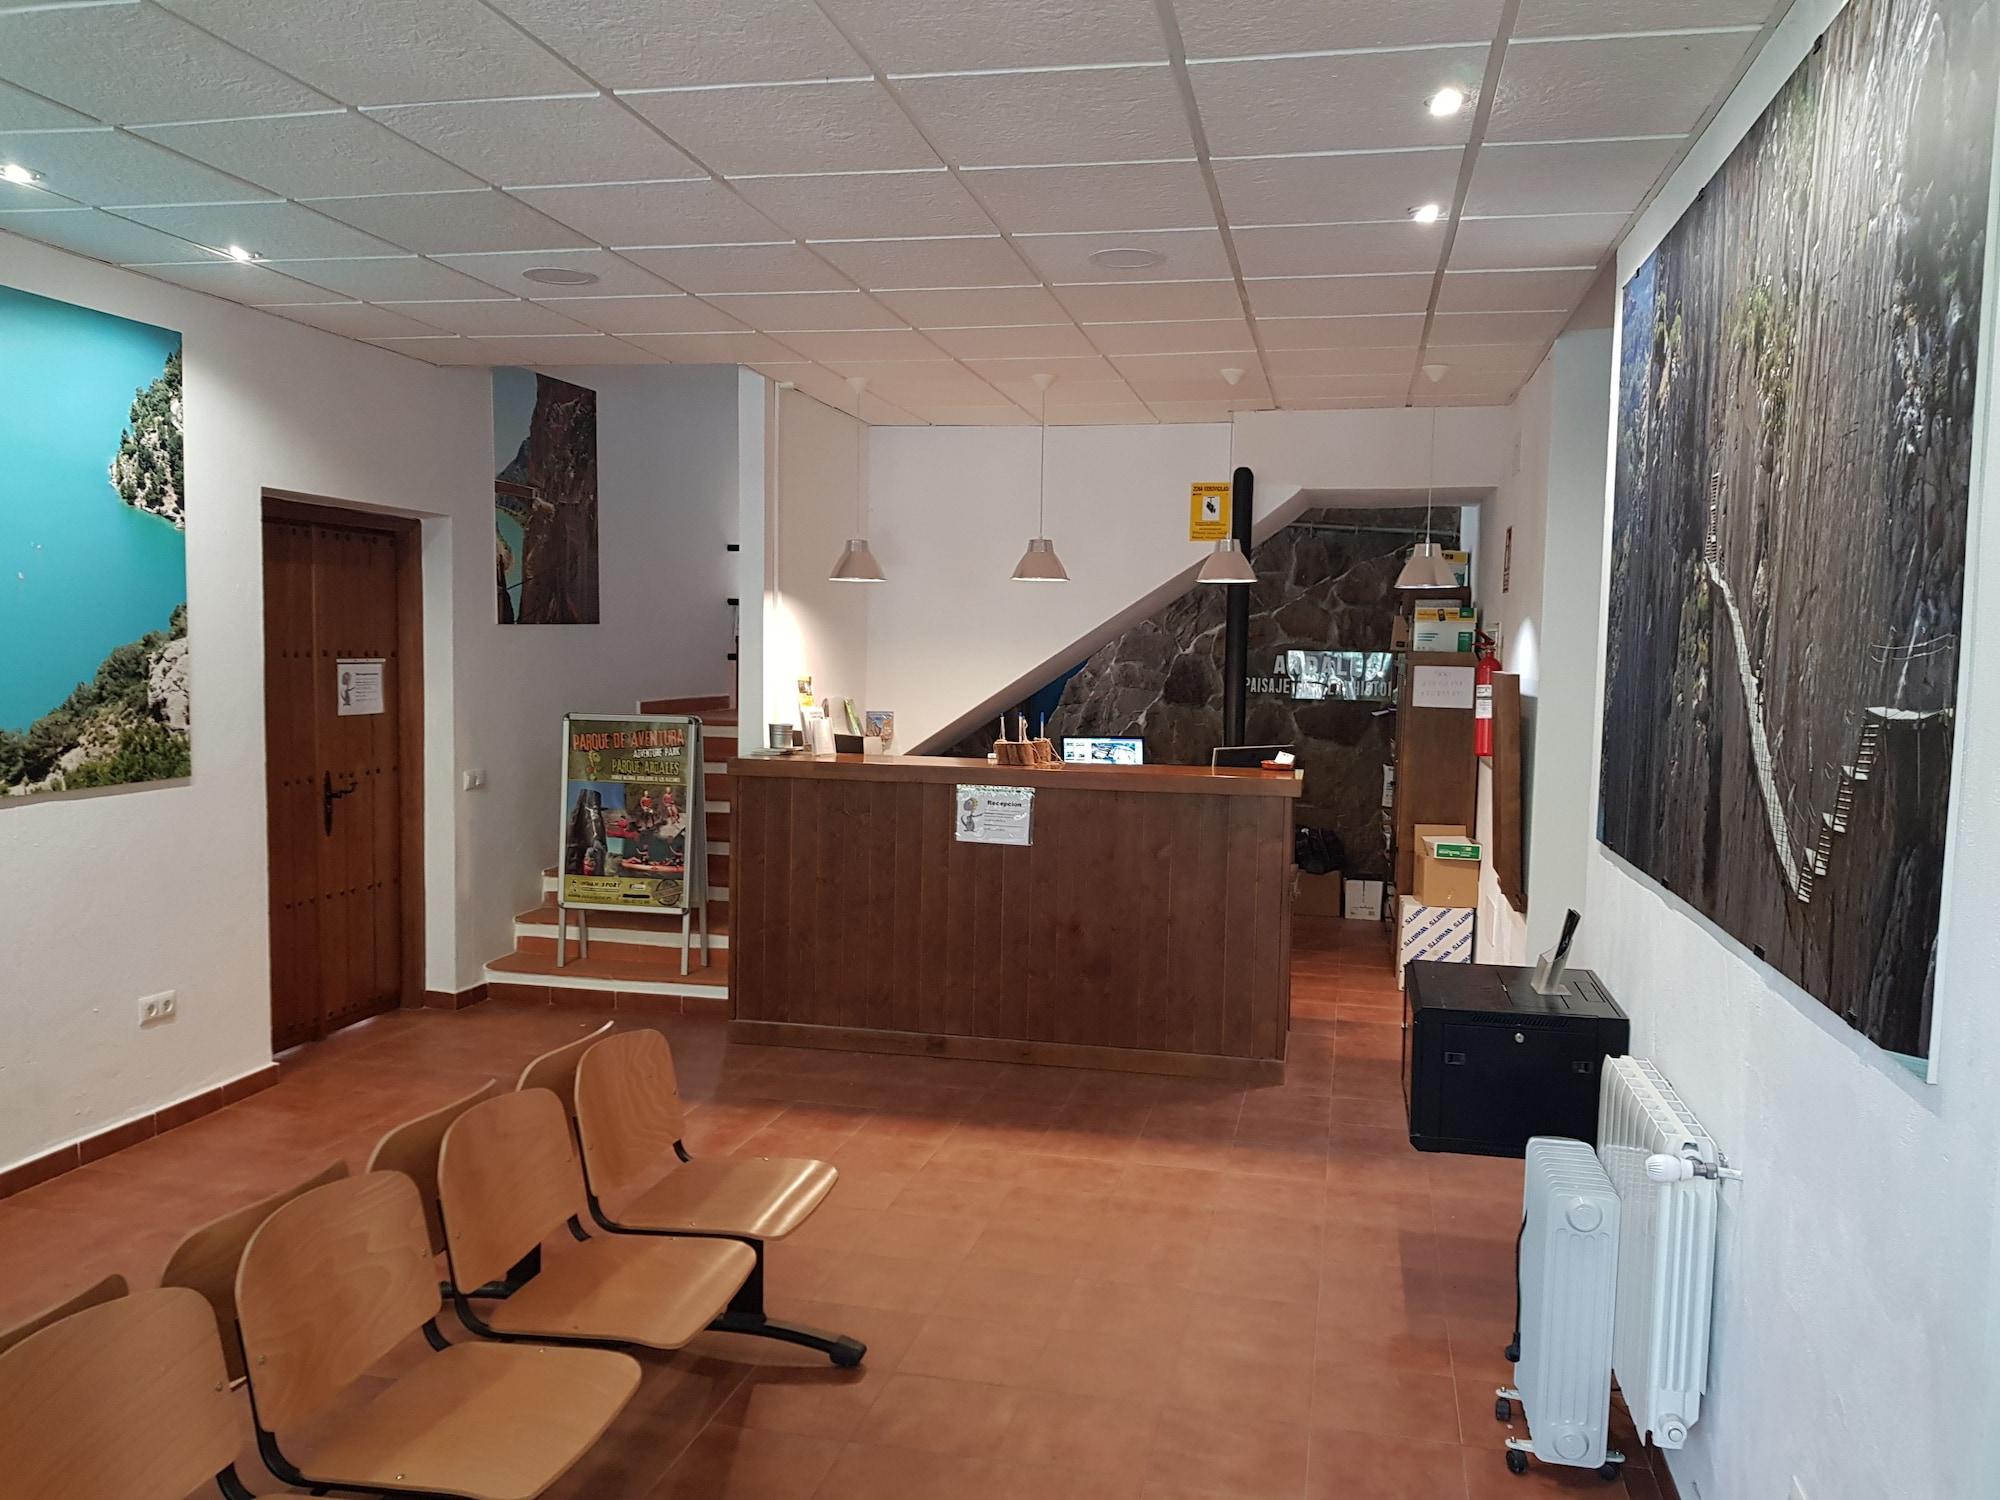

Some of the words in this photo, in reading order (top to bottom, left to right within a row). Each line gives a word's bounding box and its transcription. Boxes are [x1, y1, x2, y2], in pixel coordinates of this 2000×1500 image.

[573, 732, 610, 752] PARQUE
[613, 732, 625, 748] DE
[631, 729, 685, 747] AVENTURA
[664, 747, 681, 757] PARK
